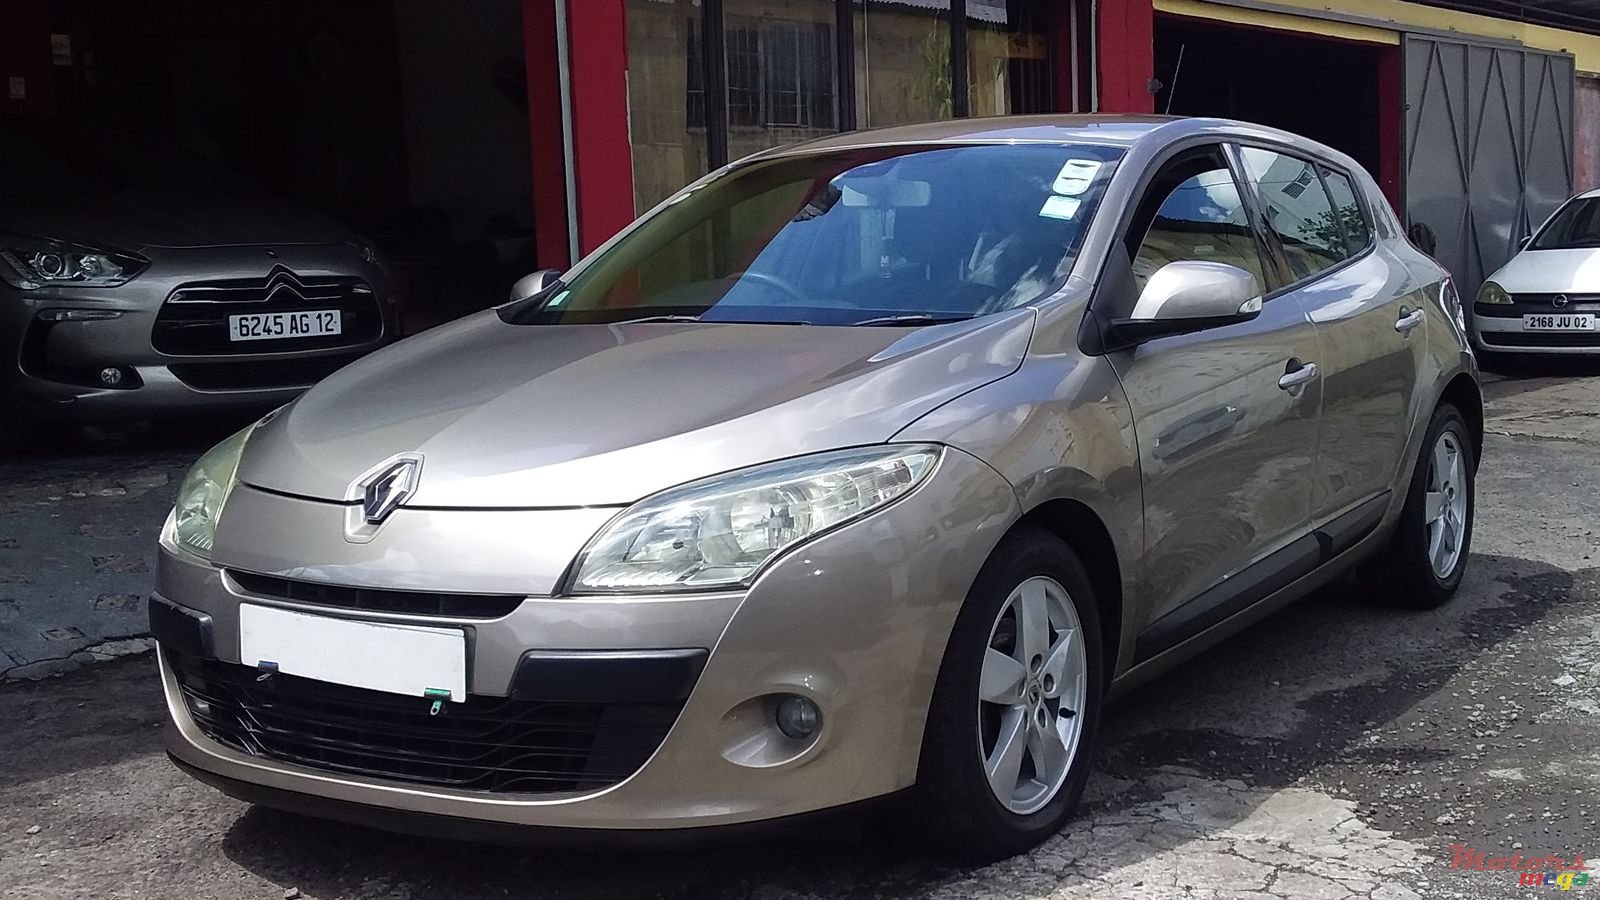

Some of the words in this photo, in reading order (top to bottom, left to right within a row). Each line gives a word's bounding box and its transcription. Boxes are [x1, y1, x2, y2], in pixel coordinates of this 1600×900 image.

[239, 316, 284, 337] 6245
[289, 314, 310, 335] AG
[316, 312, 334, 332] 12
[1529, 316, 1554, 328] 2168
[1556, 317, 1571, 328] JU
[1574, 317, 1587, 328] 02
